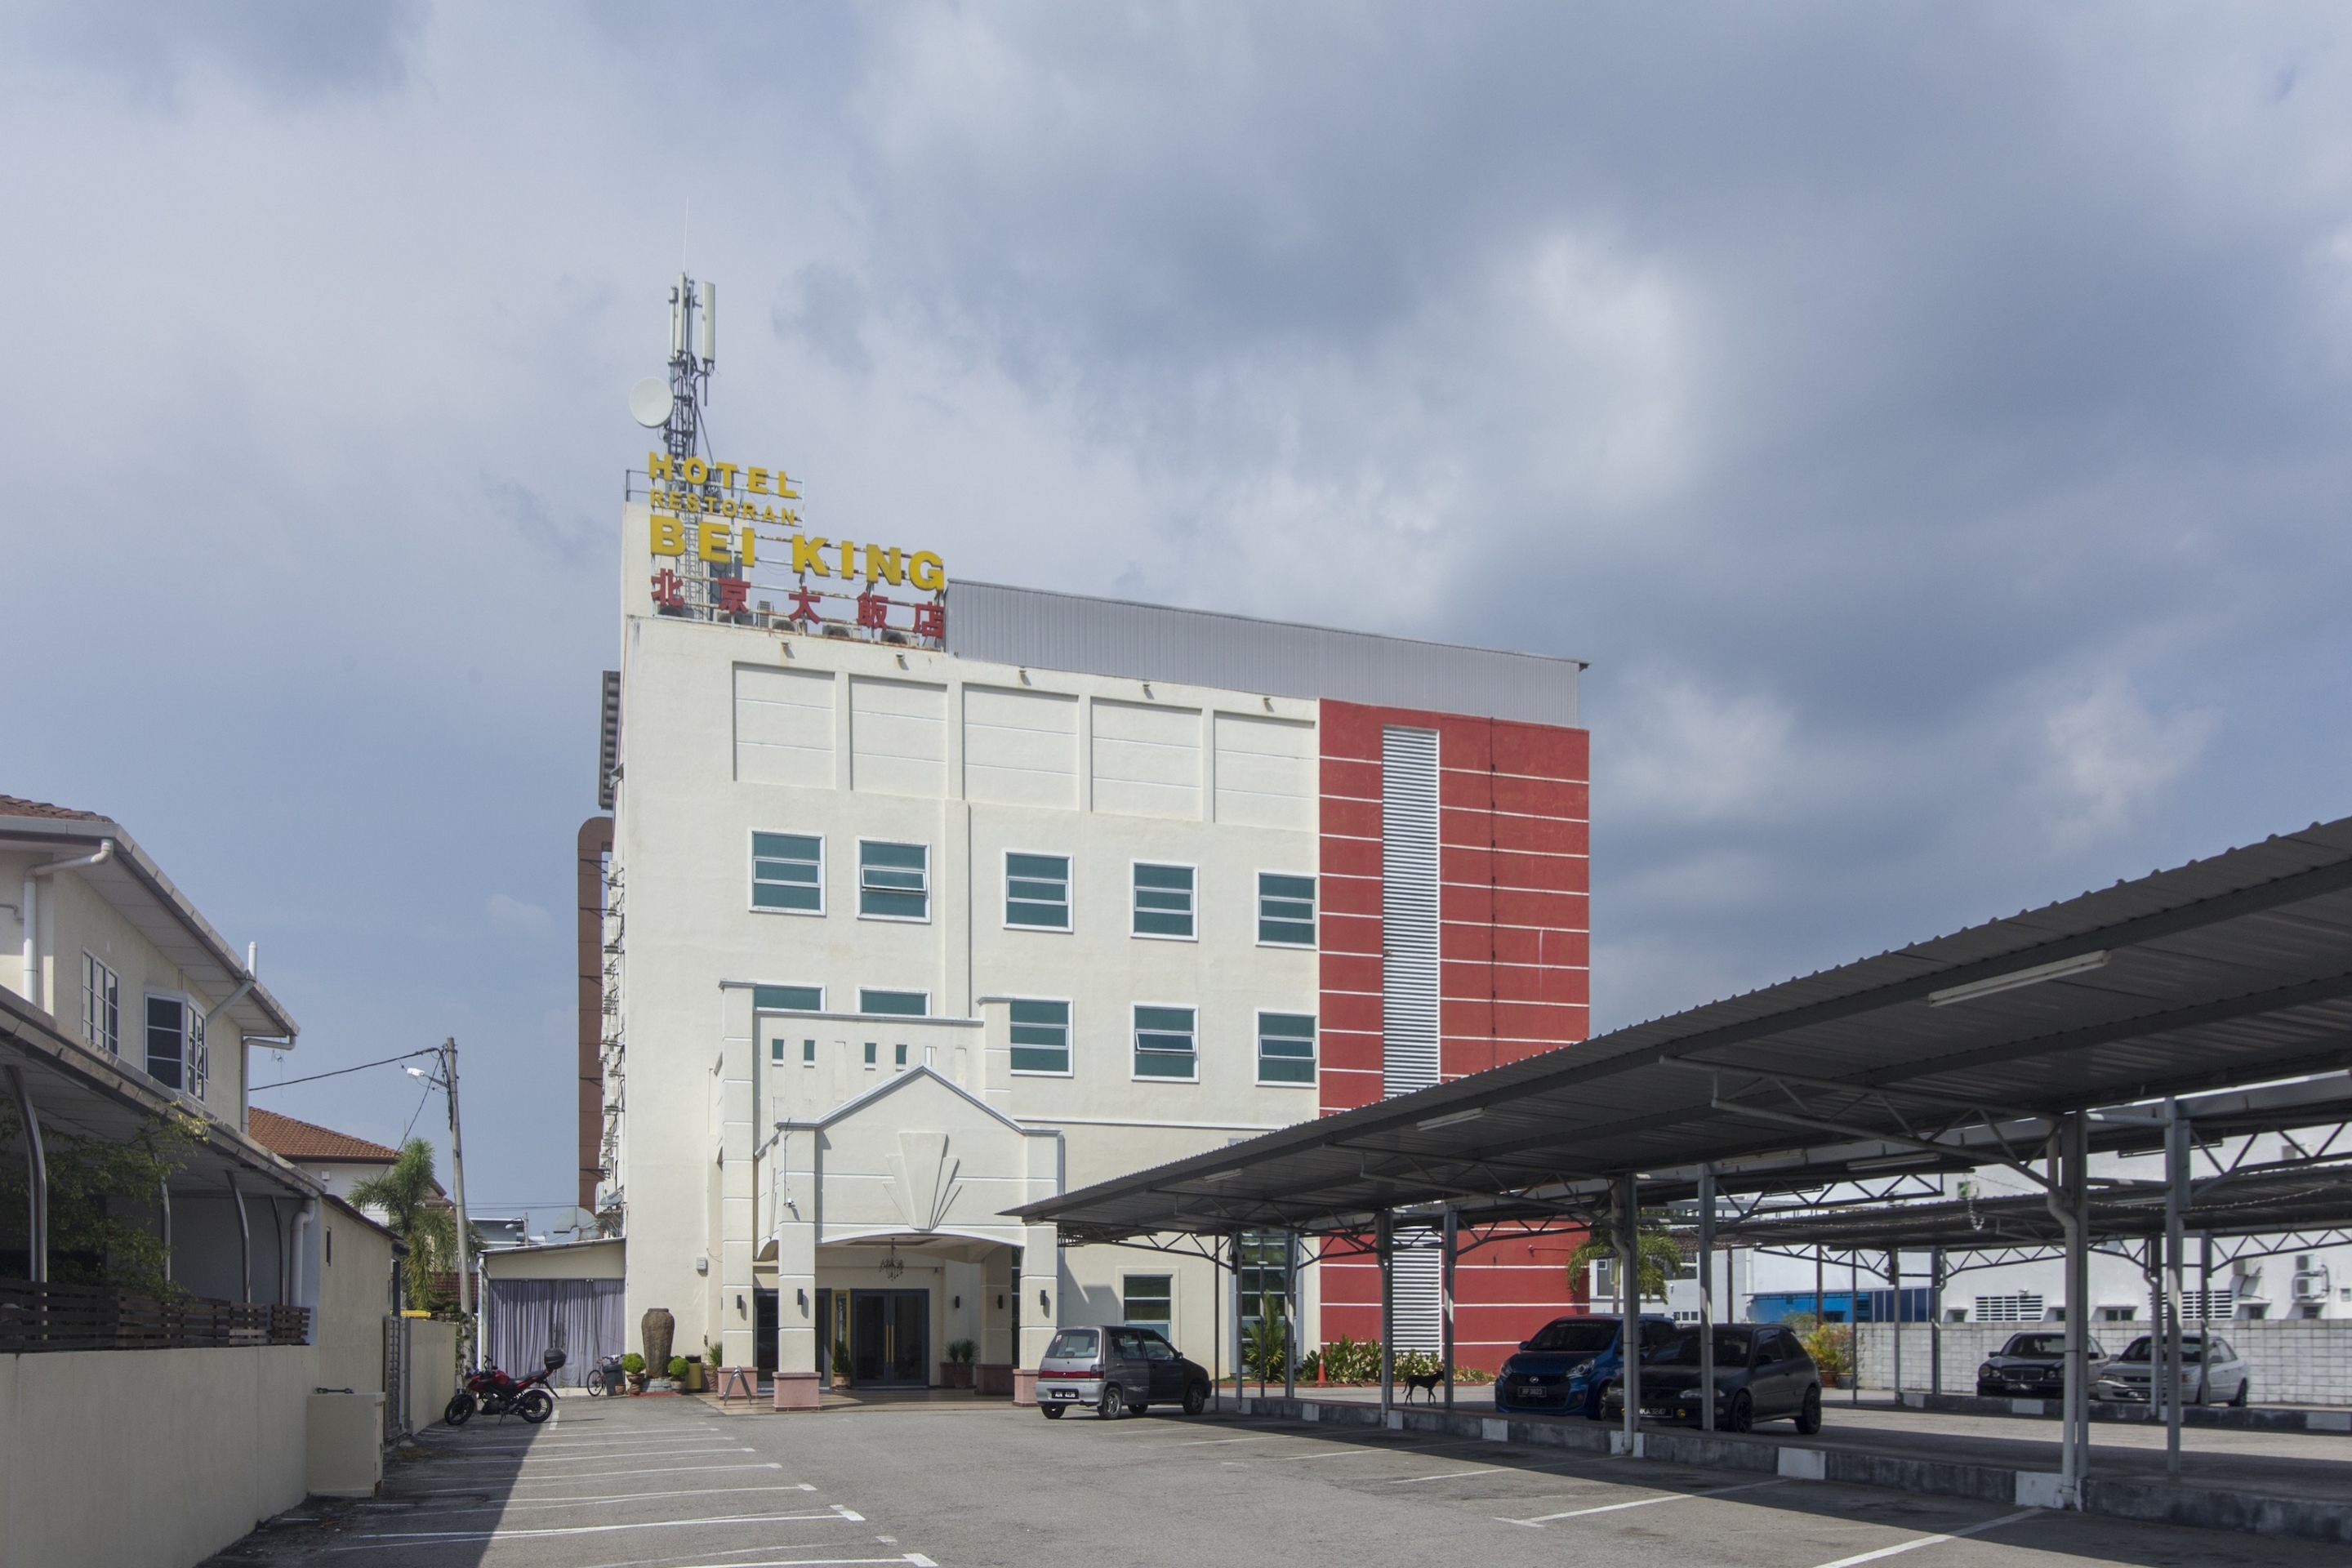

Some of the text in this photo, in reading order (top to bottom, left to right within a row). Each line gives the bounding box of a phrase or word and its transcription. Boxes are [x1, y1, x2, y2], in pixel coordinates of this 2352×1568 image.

[648, 451, 797, 499] HOTEL
[650, 488, 795, 526] RESTORAN
[650, 514, 945, 592] BEI KING
